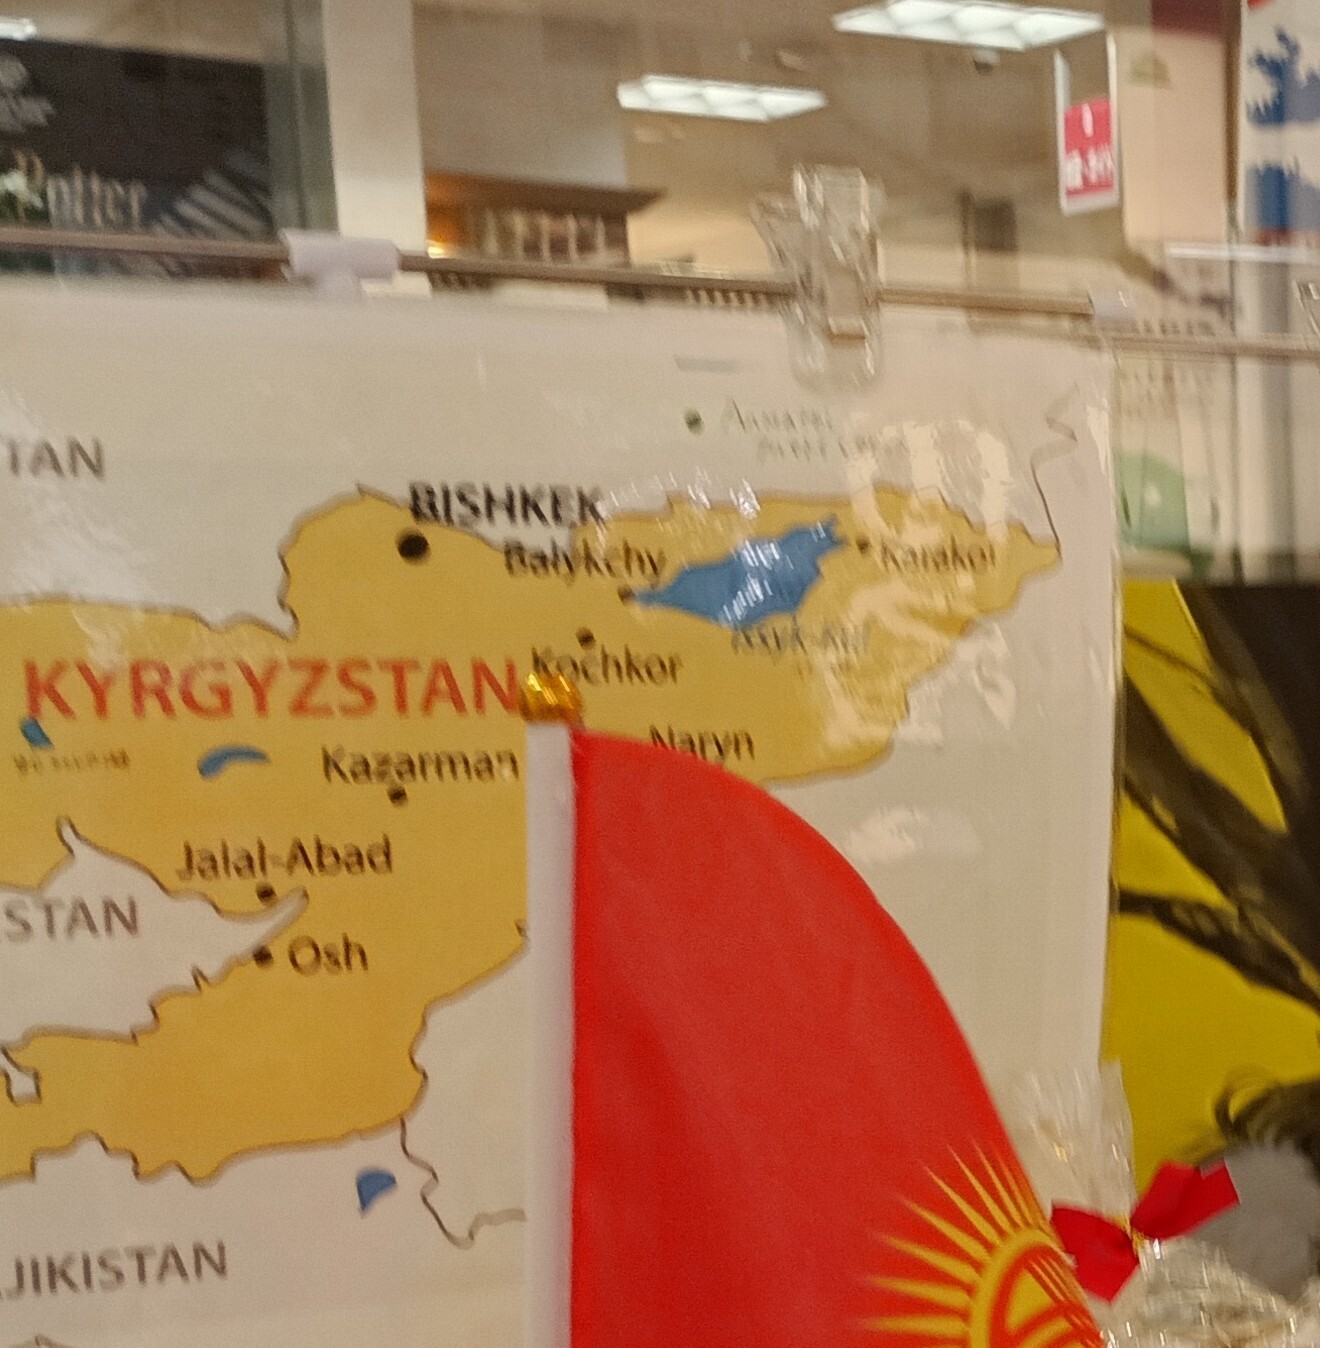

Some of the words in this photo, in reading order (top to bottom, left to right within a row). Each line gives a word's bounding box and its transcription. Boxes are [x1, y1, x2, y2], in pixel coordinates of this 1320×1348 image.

[410, 482, 605, 526] BISHKEK
[505, 538, 667, 582] Balykchy
[24, 655, 520, 720] KYRGYZSTAN
[531, 645, 682, 688] Kochkor
[322, 745, 520, 785] Kazarman
[176, 833, 395, 882] Jalal-Abad
[2, 897, 138, 942] STAN
[288, 932, 369, 976] Osh
[2, 1241, 228, 1300] JIKISTAN
